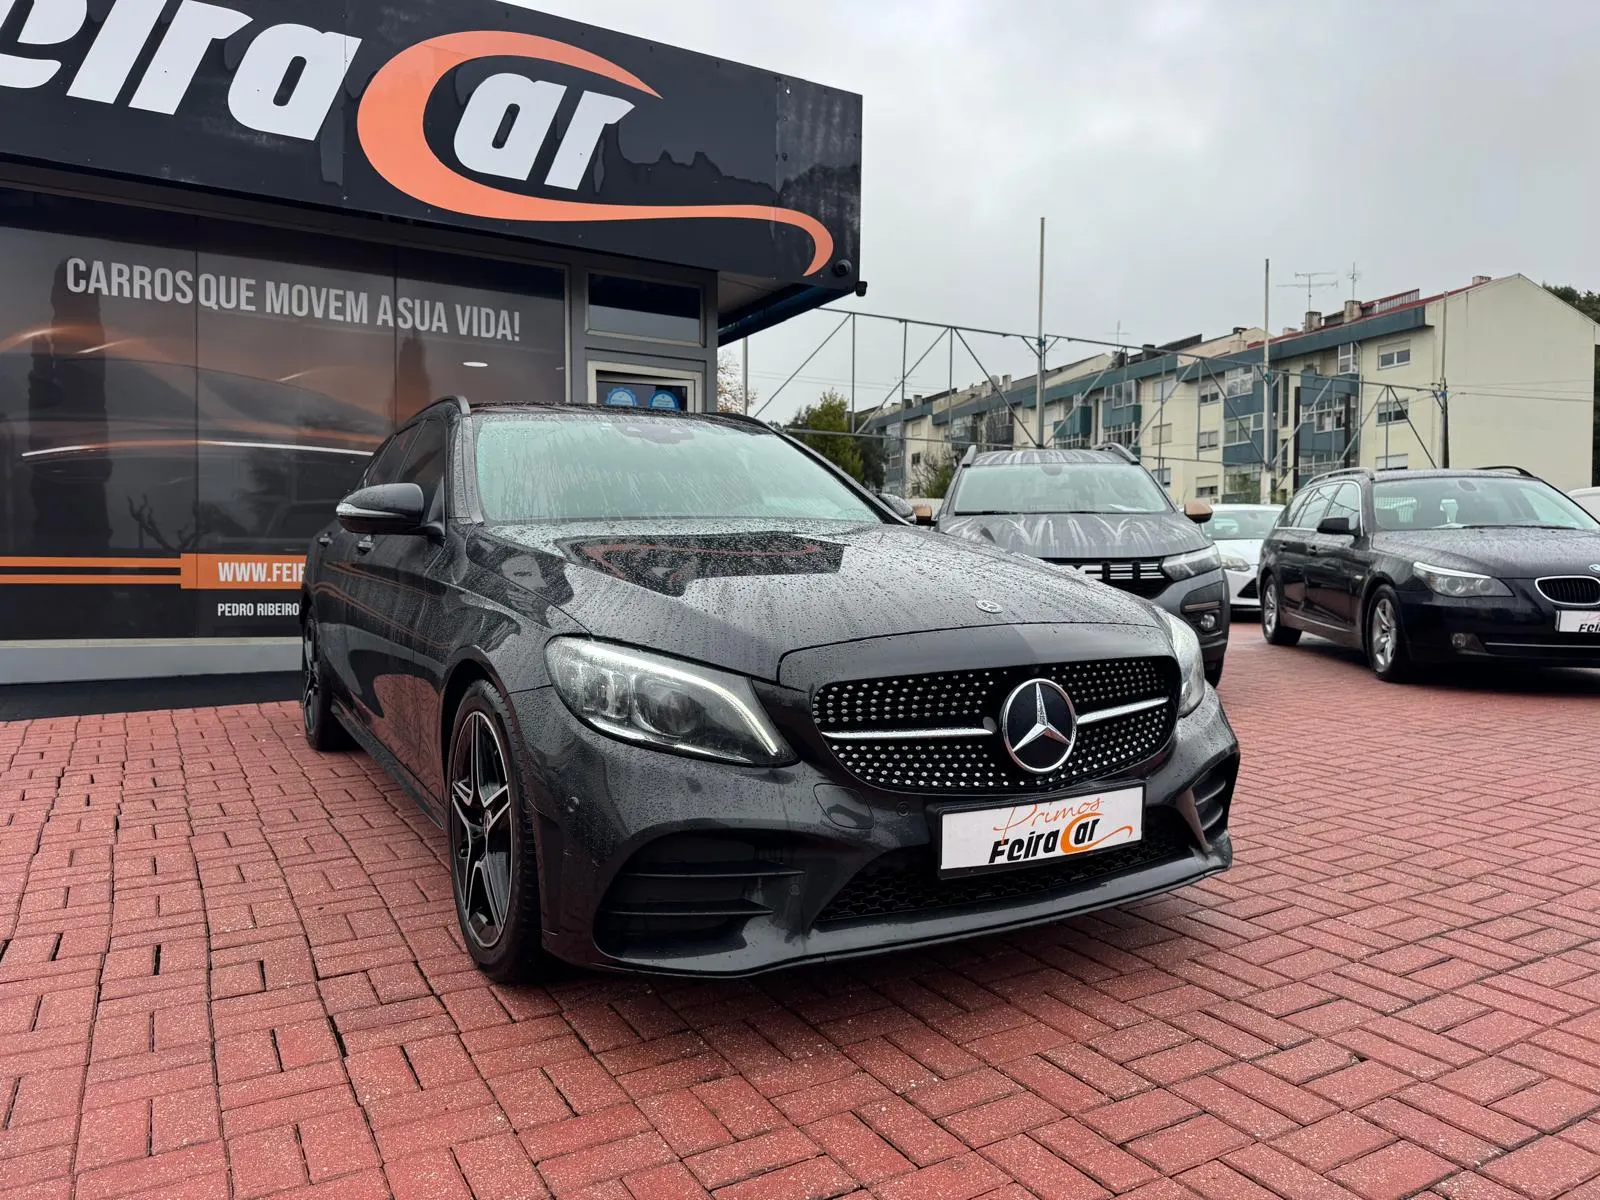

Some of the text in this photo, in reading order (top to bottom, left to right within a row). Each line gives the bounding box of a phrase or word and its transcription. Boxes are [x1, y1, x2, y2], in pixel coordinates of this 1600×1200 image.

[66, 257, 520, 342] CARROS QUE MOVEM A SUA VIDA!
[217, 603, 300, 617] PEDRO RIBEIRO
[1578, 621, 1600, 632] Fei
[992, 796, 1105, 845] Primos
